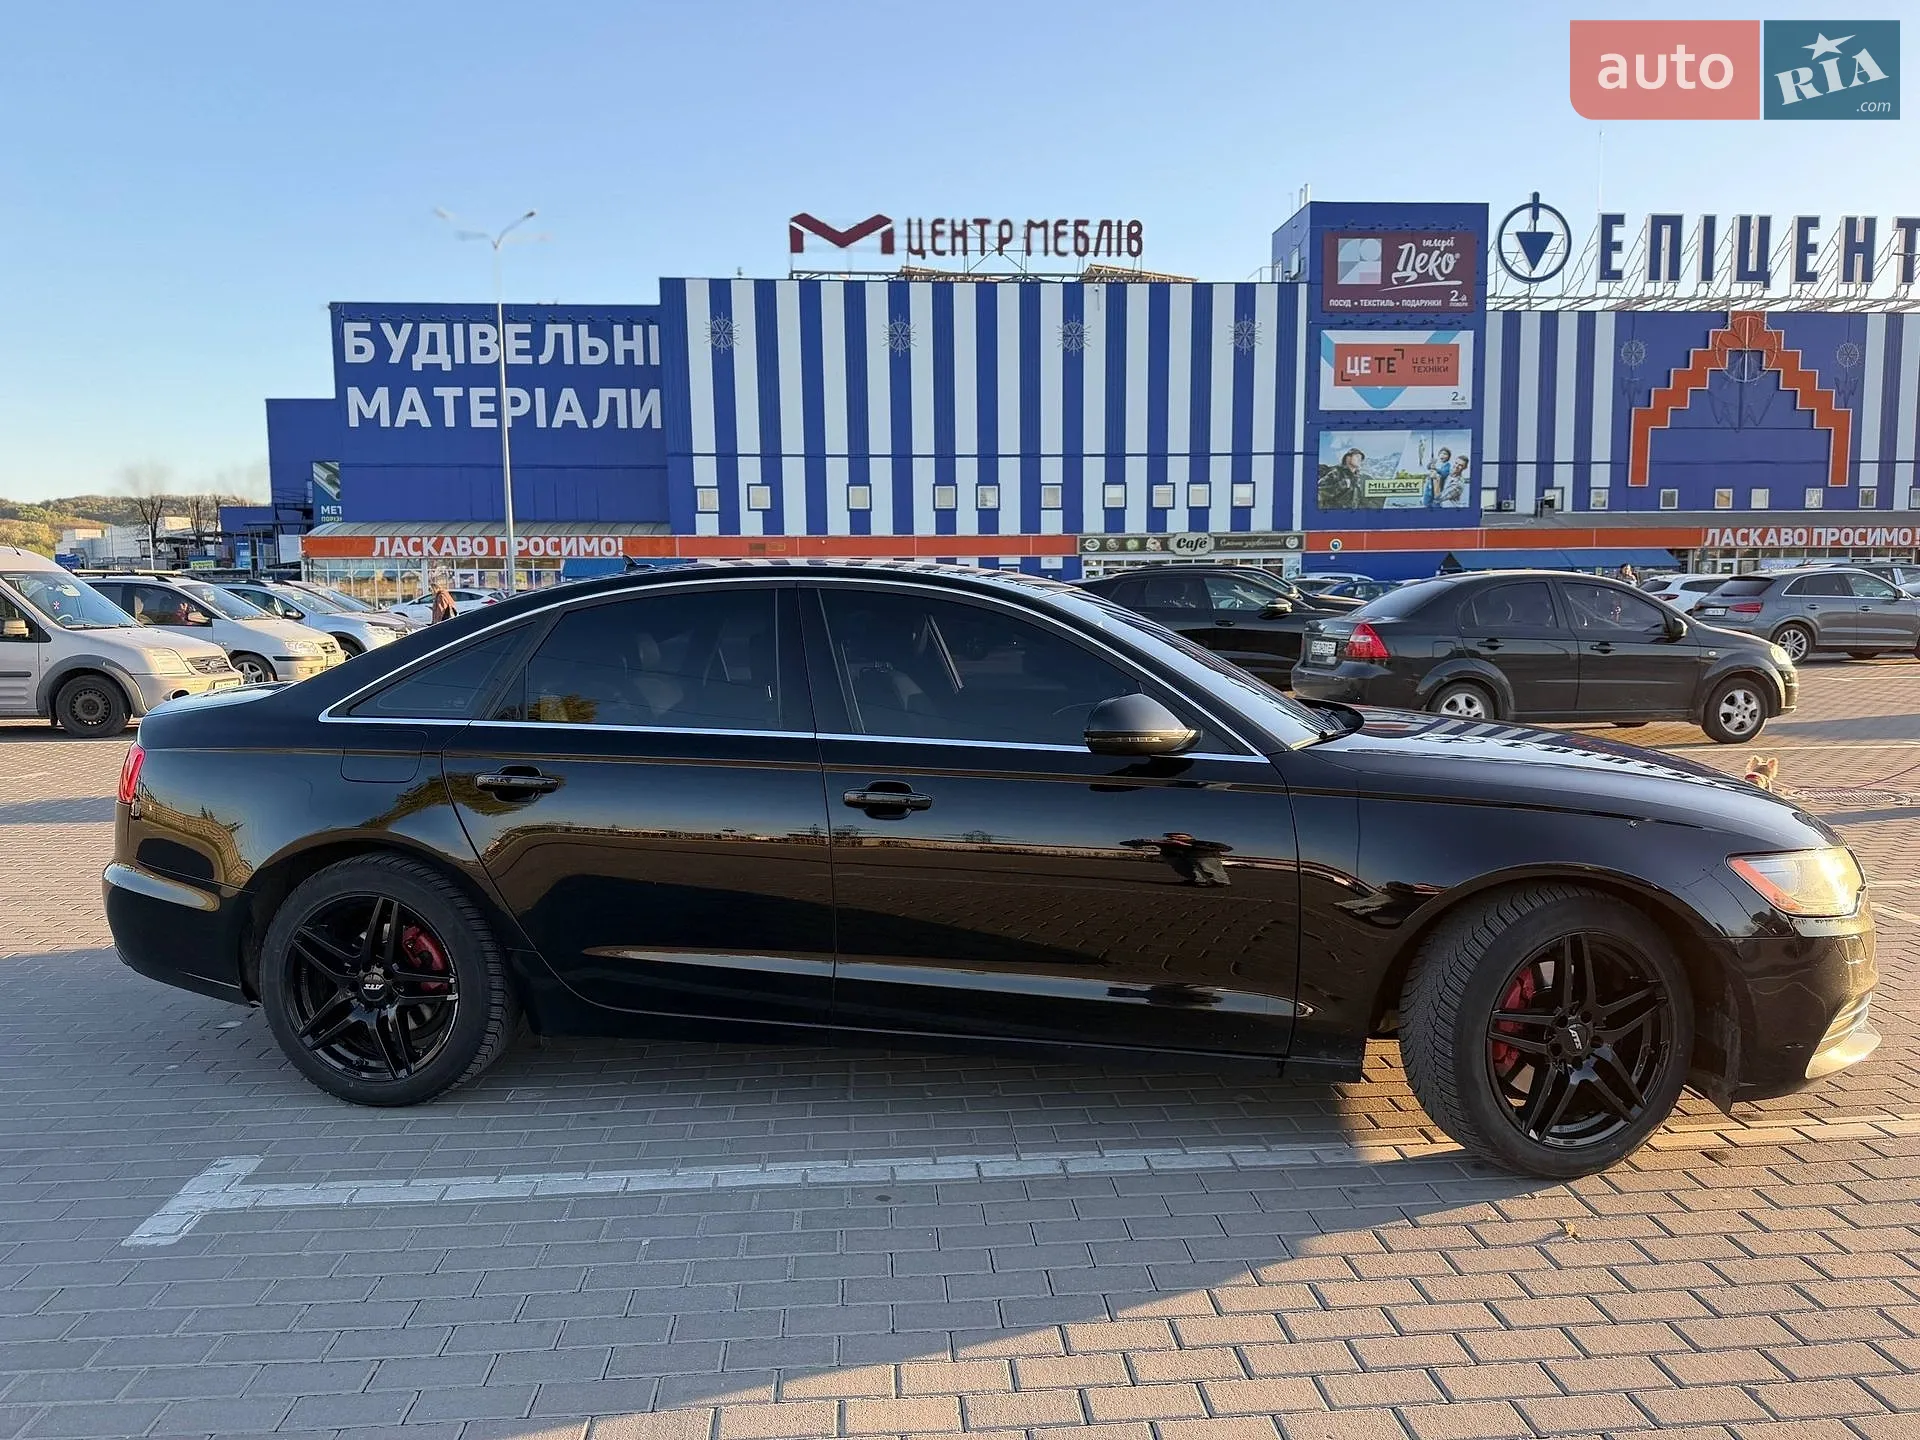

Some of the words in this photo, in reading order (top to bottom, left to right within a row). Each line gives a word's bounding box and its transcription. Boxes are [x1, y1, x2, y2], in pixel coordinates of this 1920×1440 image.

[906, 217, 1013, 259] ЦЕНТР
[1026, 218, 1143, 258] МЕБЛІВ
[1597, 213, 1920, 290] ЕПІЦЕНТ
[1391, 242, 1457, 285] Деко
[1329, 299, 1352, 307] ПОСУД
[1360, 299, 1396, 307] ТЕКСТИЛЬ
[1402, 299, 1442, 308] ПОДАРУНКИ
[343, 322, 661, 371] БУДІВЕЛЬНІ
[1412, 356, 1449, 365] ЦЕНТР
[347, 386, 662, 429] МАТЕРІАЛИ
[372, 536, 489, 557] ЛАСКАВО
[495, 536, 623, 557] ПРОСИМО!
[1176, 536, 1208, 551] Café
[1704, 527, 1807, 547] ЛАСКАВО
[1812, 527, 1920, 547] ПРОСИМО!
